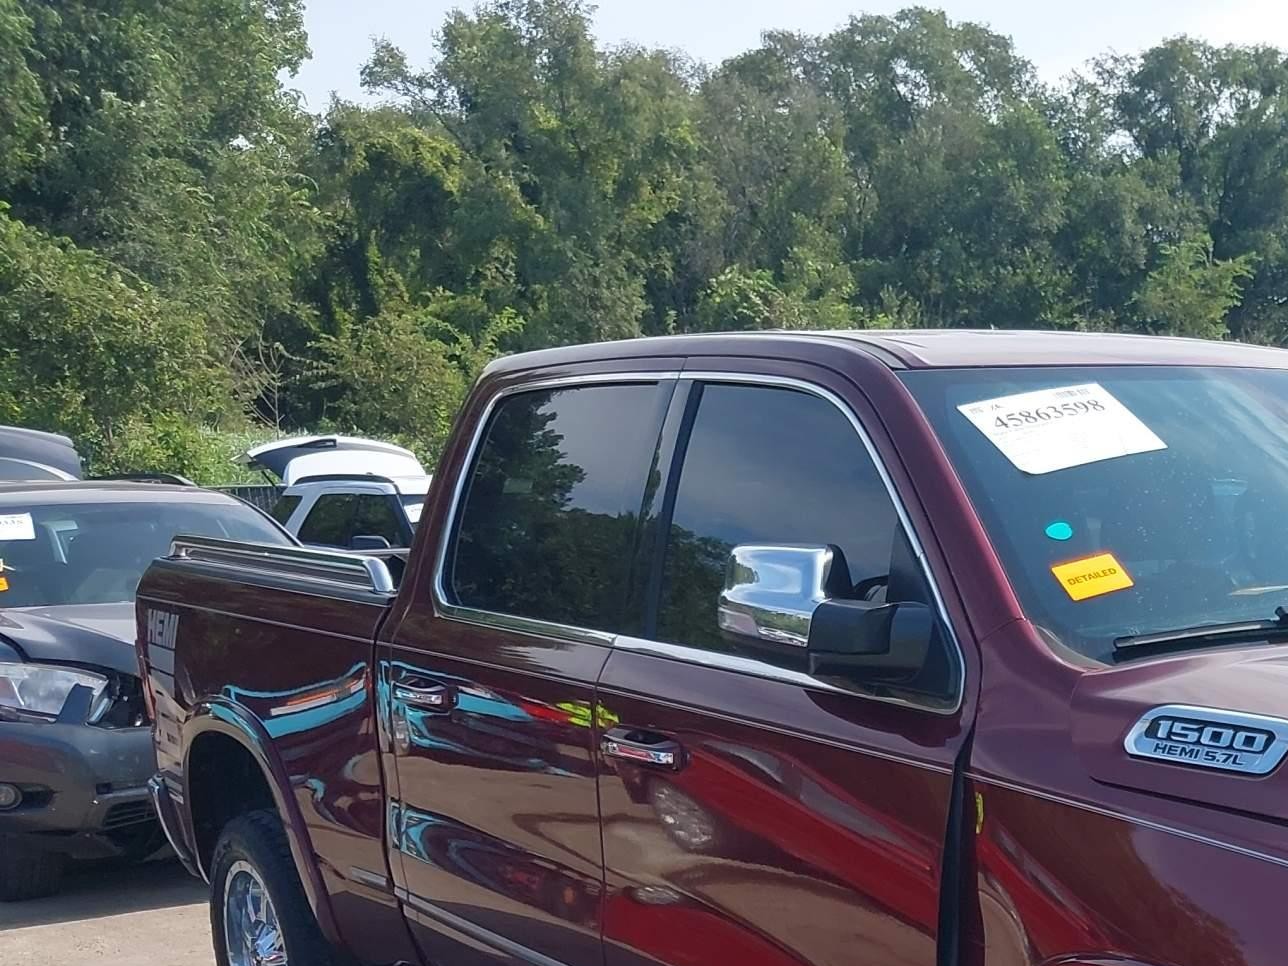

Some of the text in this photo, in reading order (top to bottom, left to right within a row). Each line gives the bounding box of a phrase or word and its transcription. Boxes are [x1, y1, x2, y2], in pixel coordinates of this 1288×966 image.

[994, 399, 1106, 429] 45863598
[1066, 567, 1117, 586] DETAILED
[1156, 719, 1270, 753] 1500
[1153, 742, 1245, 766] HEMI 5.7L
